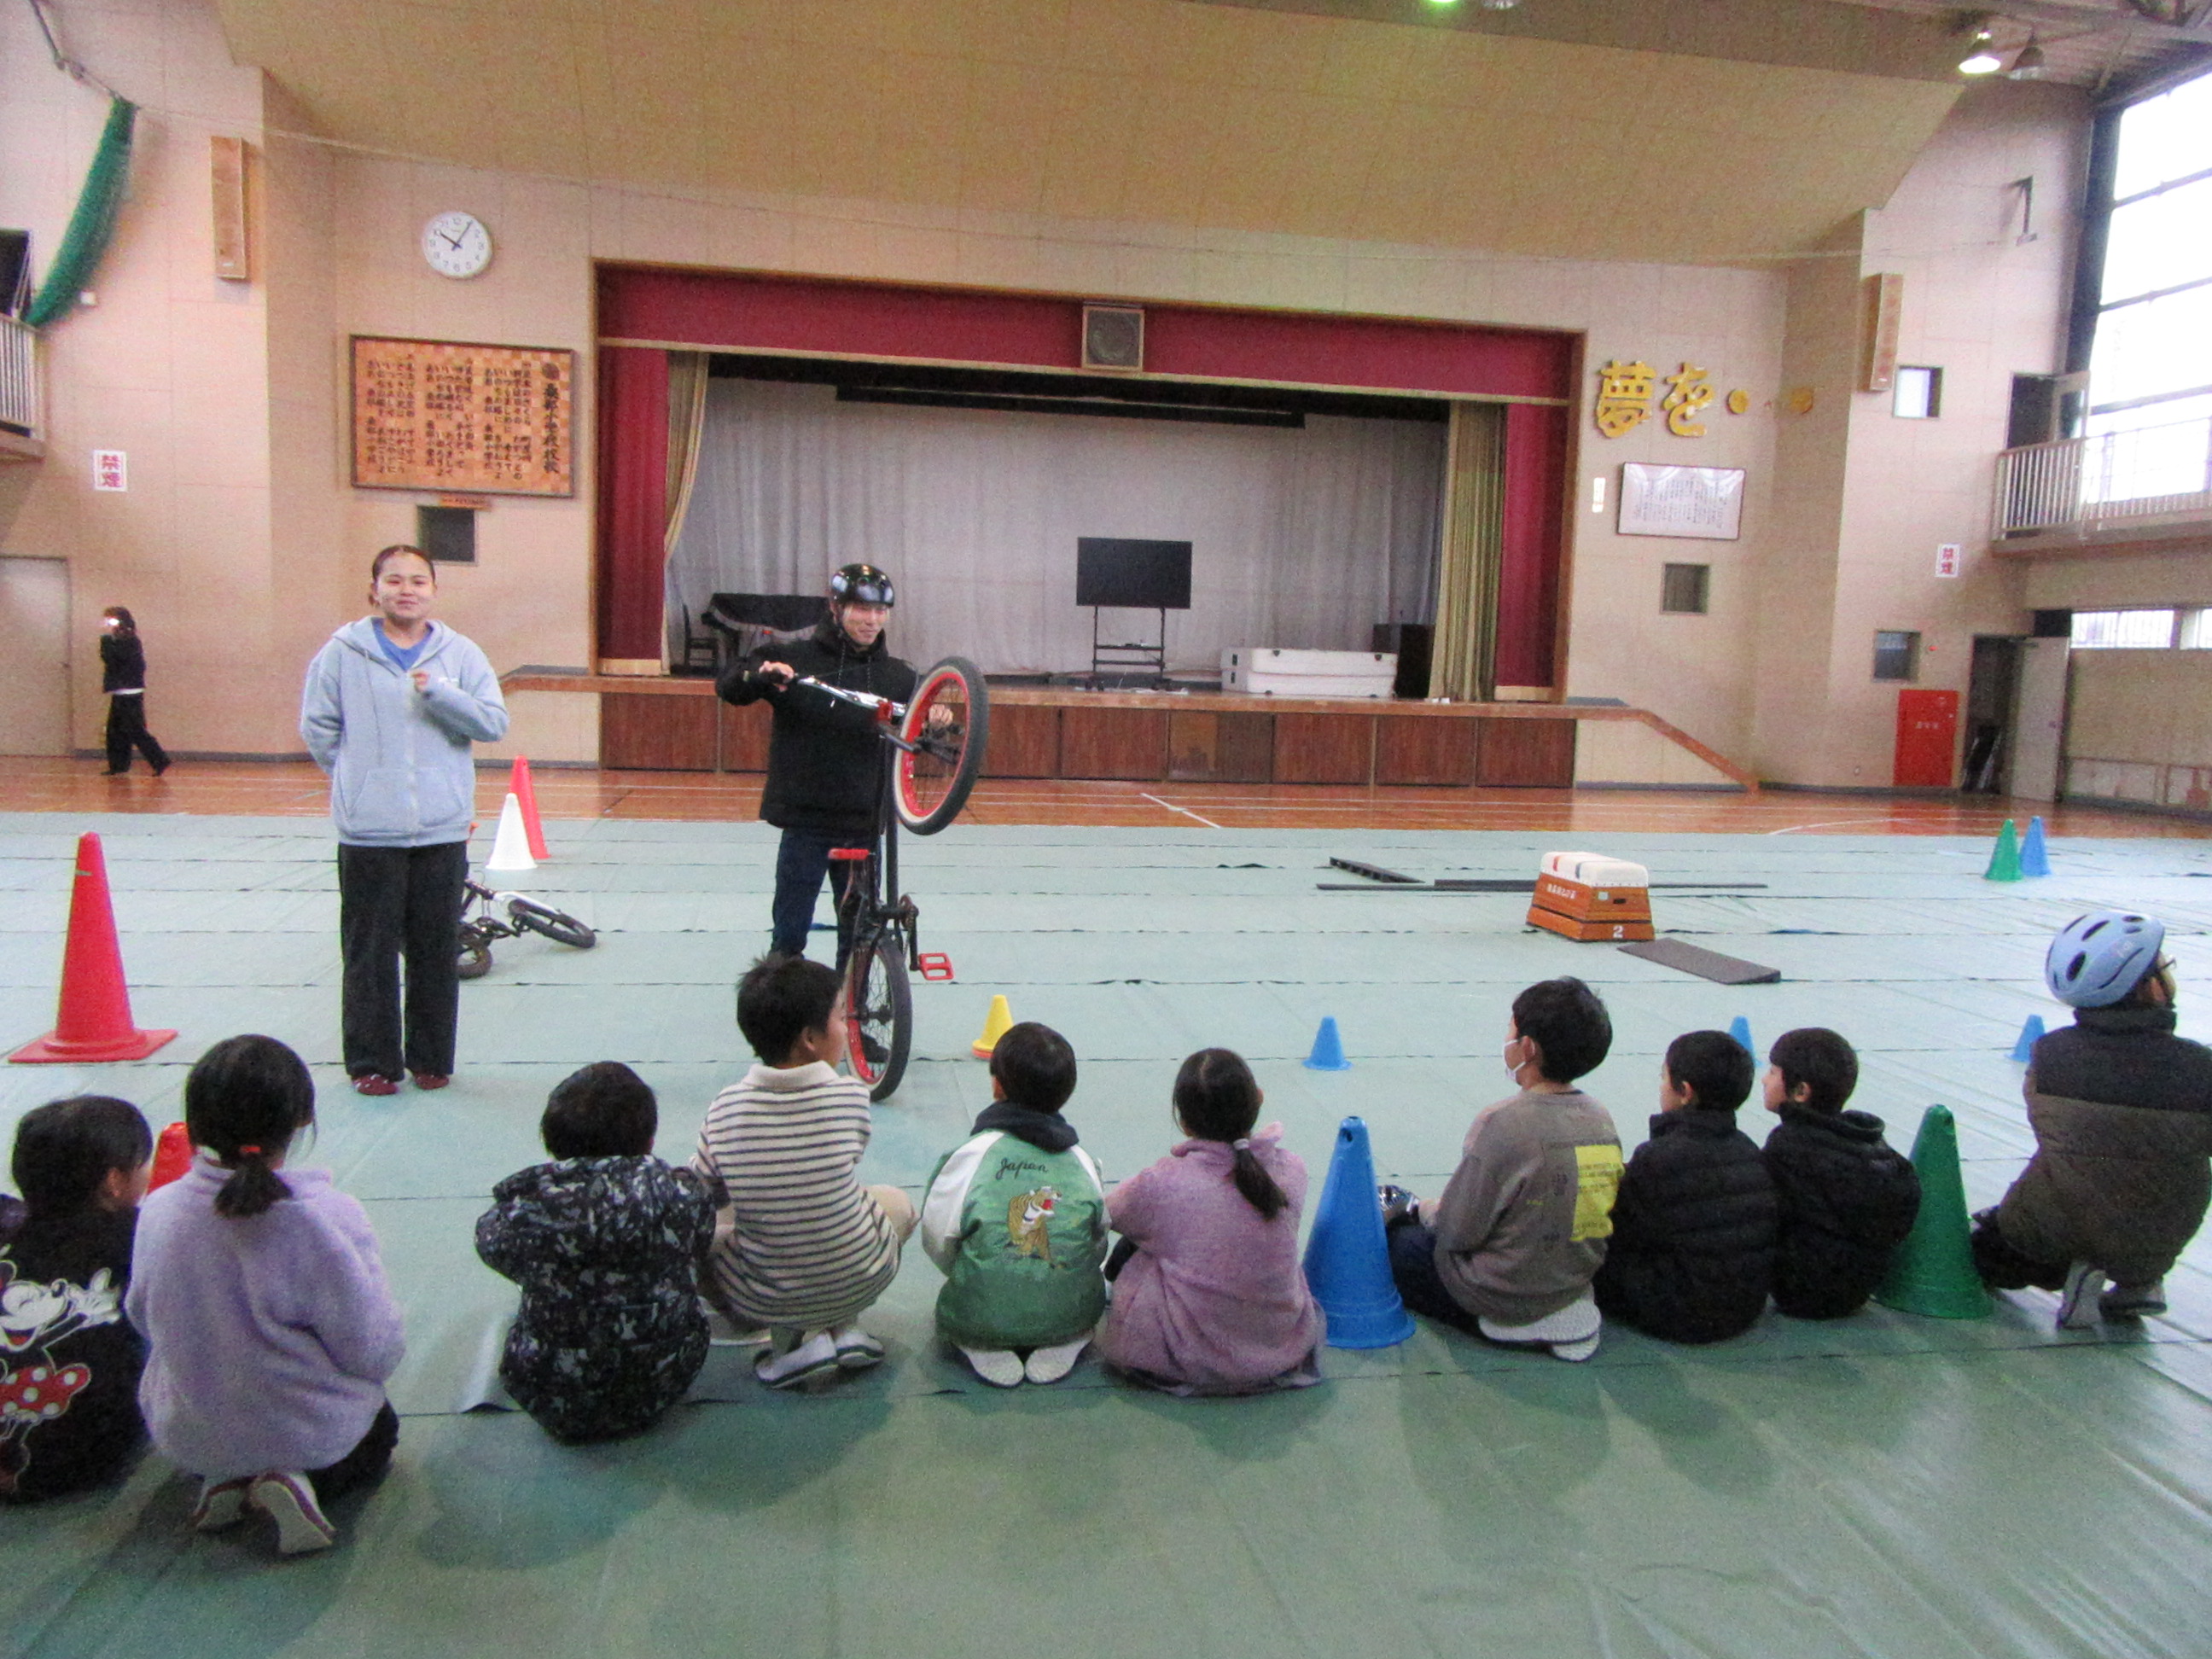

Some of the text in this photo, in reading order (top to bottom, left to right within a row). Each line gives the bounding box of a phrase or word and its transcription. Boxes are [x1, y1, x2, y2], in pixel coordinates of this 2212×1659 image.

[102, 454, 123, 488] 禁煙
[1941, 547, 1954, 575] 禁煙
[1613, 925, 1623, 938] 2
[995, 1157, 1049, 1180] Japan
